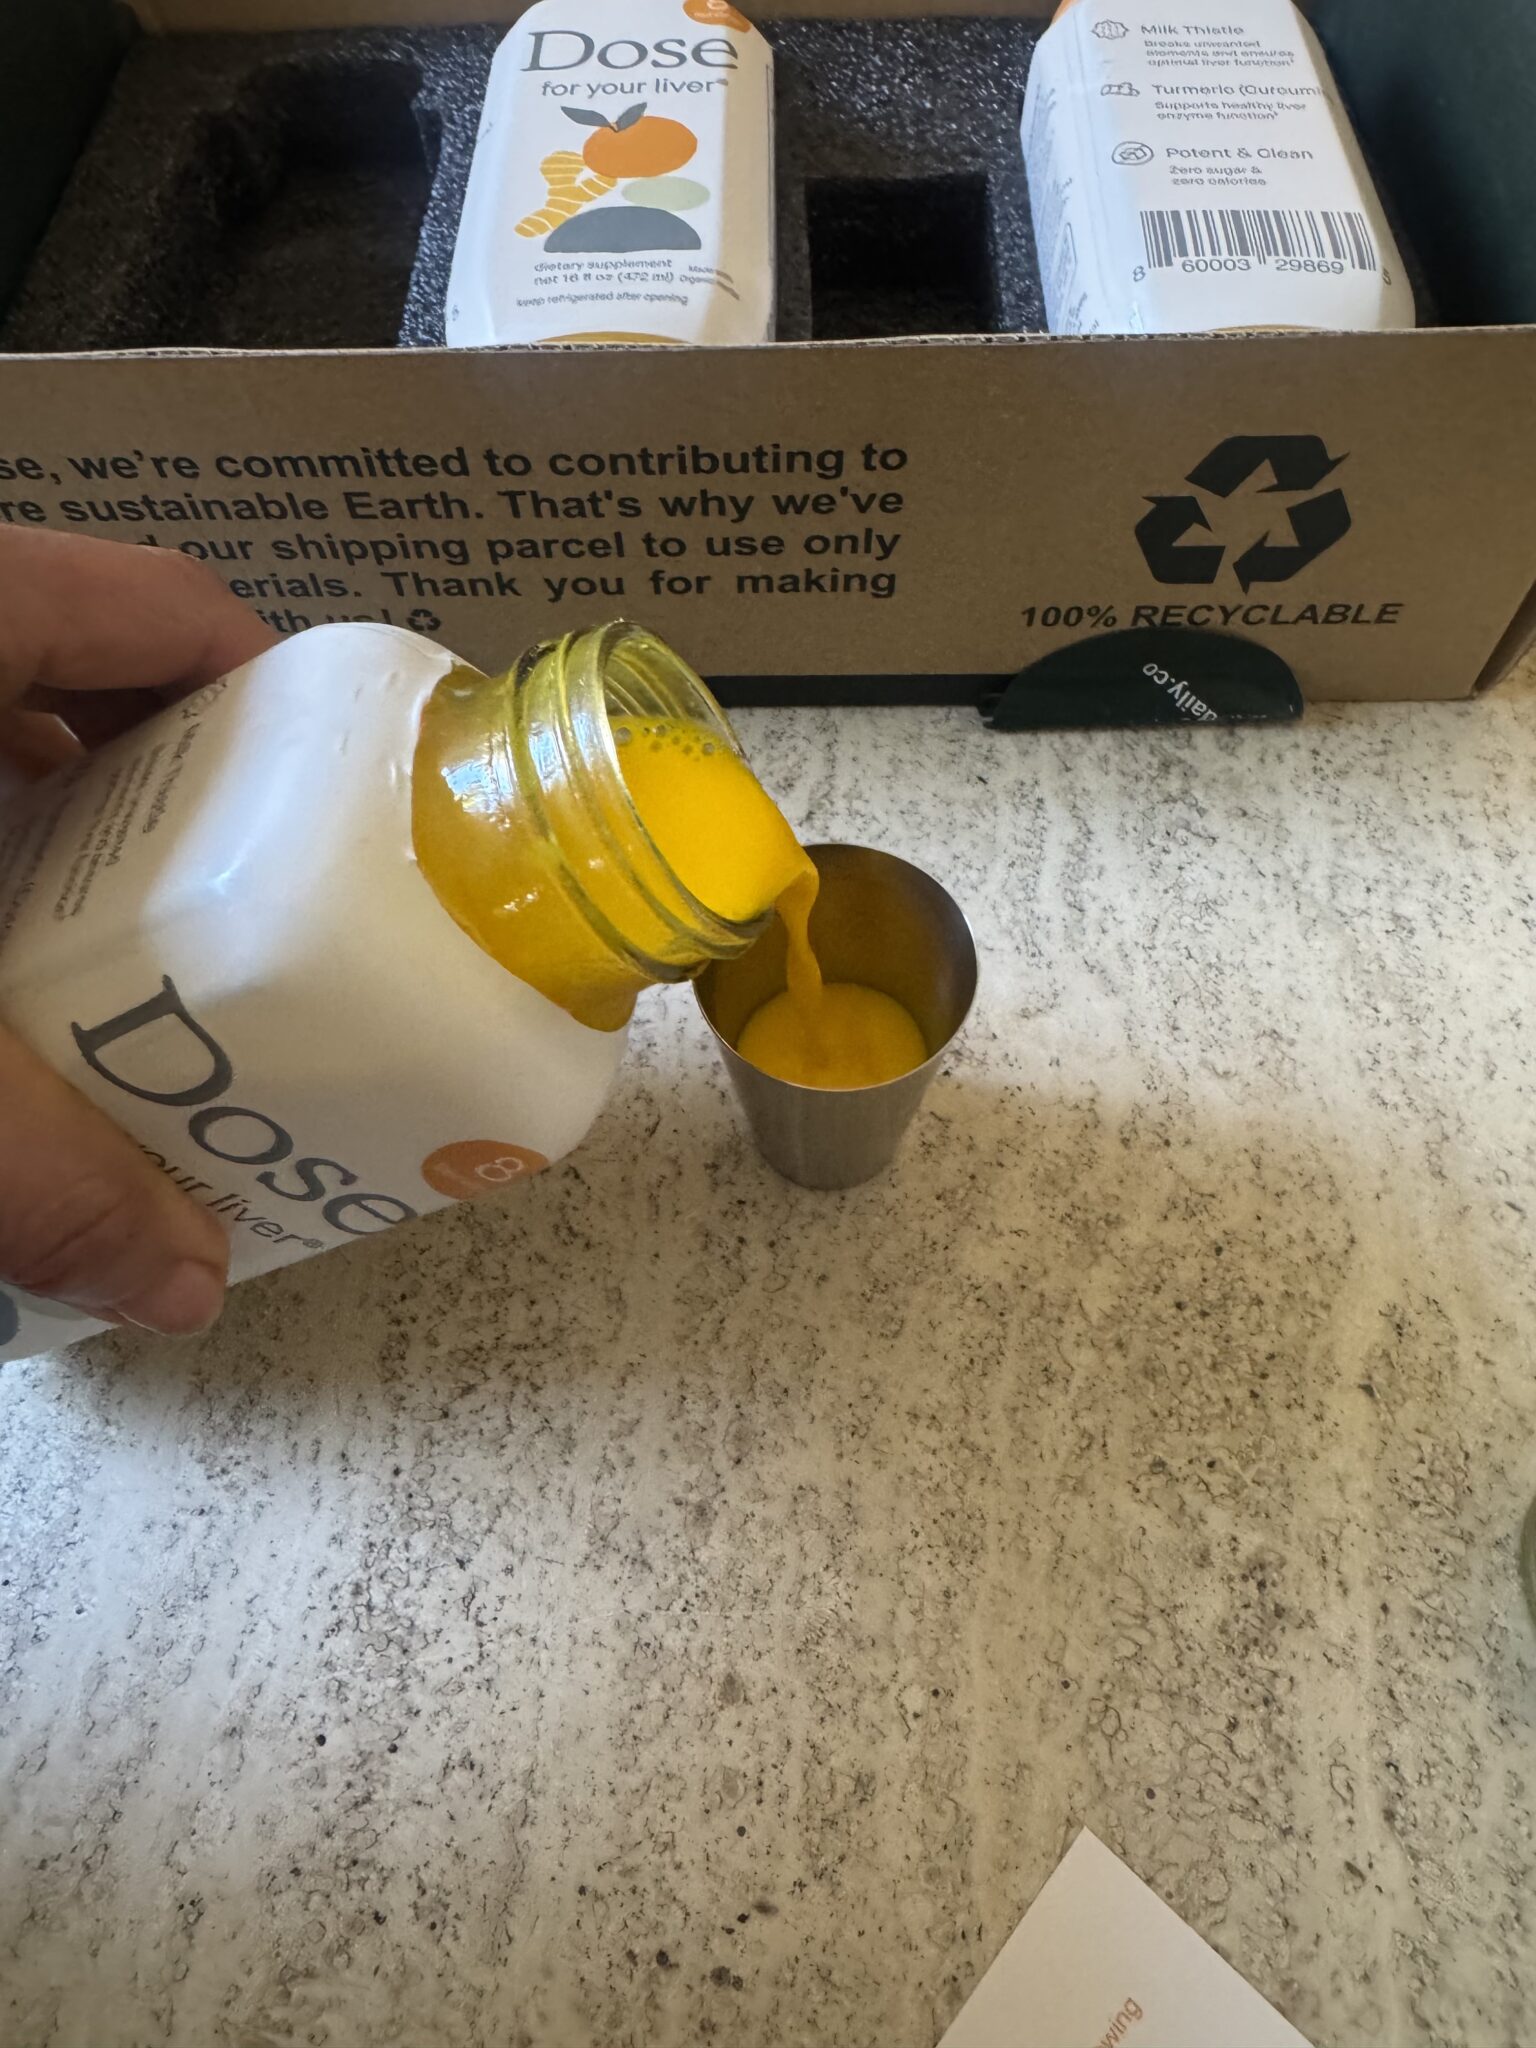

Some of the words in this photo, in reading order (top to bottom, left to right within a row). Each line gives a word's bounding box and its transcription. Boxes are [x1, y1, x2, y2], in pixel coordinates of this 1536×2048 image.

[1140, 24, 1179, 35] Milk
[1183, 24, 1244, 35] Thistle
[520, 29, 738, 71] Dose
[1144, 40, 1191, 48] Breaks
[1194, 40, 1260, 48] unwanted
[1212, 49, 1238, 57] and
[1148, 58, 1199, 67] optimal
[1202, 58, 1230, 67] liver
[541, 80, 581, 97] for
[587, 81, 647, 99] your
[1152, 83, 1235, 96] Turmeric
[1154, 101, 1219, 112] Supports
[1222, 101, 1273, 112] healthy
[1277, 102, 1307, 112] liver
[1156, 112, 1213, 121] enzyme
[1166, 147, 1232, 159] Potent
[1236, 147, 1252, 159] &
[1257, 148, 1314, 160] Clean
[1169, 165, 1202, 175] Zero
[1206, 165, 1247, 177] sugar
[1251, 165, 1263, 175] &
[1172, 177, 1204, 186] zero
[1207, 176, 1267, 186] calories
[534, 260, 584, 273] dietary
[587, 258, 673, 271] supplement
[1132, 265, 1146, 283] 8
[1182, 258, 1252, 273] 60003
[1275, 258, 1345, 274] 29869
[534, 274, 559, 286] net
[547, 291, 613, 304] refrigerated
[616, 291, 641, 302] after
[215, 446, 471, 480] committed
[484, 446, 532, 477] to
[548, 443, 845, 480] contributing
[861, 443, 908, 473] to
[60, 492, 330, 522] sustainable
[343, 490, 484, 521] Earth.
[497, 489, 643, 519] That's
[659, 488, 754, 523] why
[772, 486, 905, 515] we've
[179, 539, 254, 561] our
[271, 532, 471, 566] shipping
[488, 531, 625, 565] parcel
[641, 531, 687, 558] to
[705, 533, 785, 557] use
[803, 527, 901, 561] only
[229, 573, 362, 598] erials.
[381, 571, 522, 597] Thank
[542, 575, 625, 603] you
[647, 569, 712, 596] for
[736, 567, 897, 598] making
[256, 609, 313, 633] ith
[1021, 604, 1118, 628] 100%
[1131, 602, 1405, 628] RECYCLABLE
[70, 974, 418, 1235] Dose
[1094, 1996, 1144, 2048] wing
